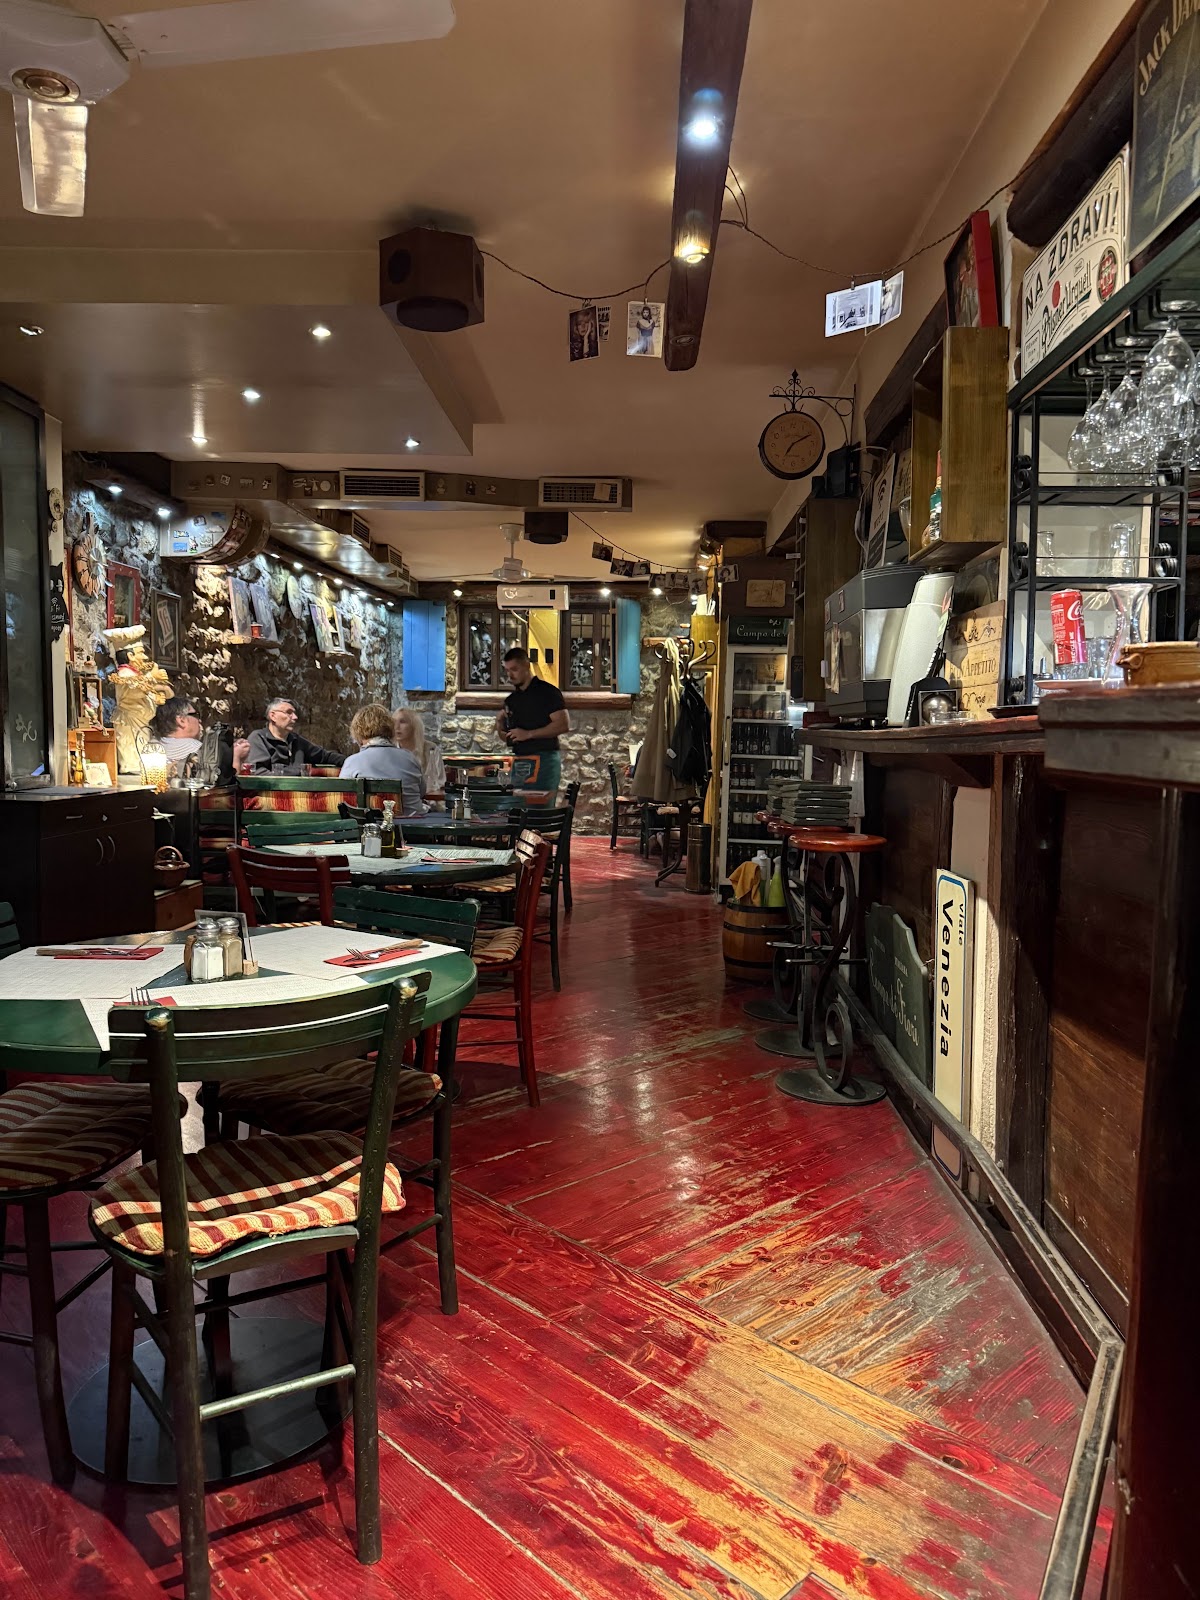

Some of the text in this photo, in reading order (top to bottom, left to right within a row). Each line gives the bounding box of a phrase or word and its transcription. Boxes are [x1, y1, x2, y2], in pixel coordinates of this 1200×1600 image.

[1139, 16, 1171, 97] JACK
[1025, 272, 1044, 321] NA
[1065, 260, 1093, 312] Urquell
[736, 624, 768, 641] Campo
[940, 899, 954, 1057] Venezia
